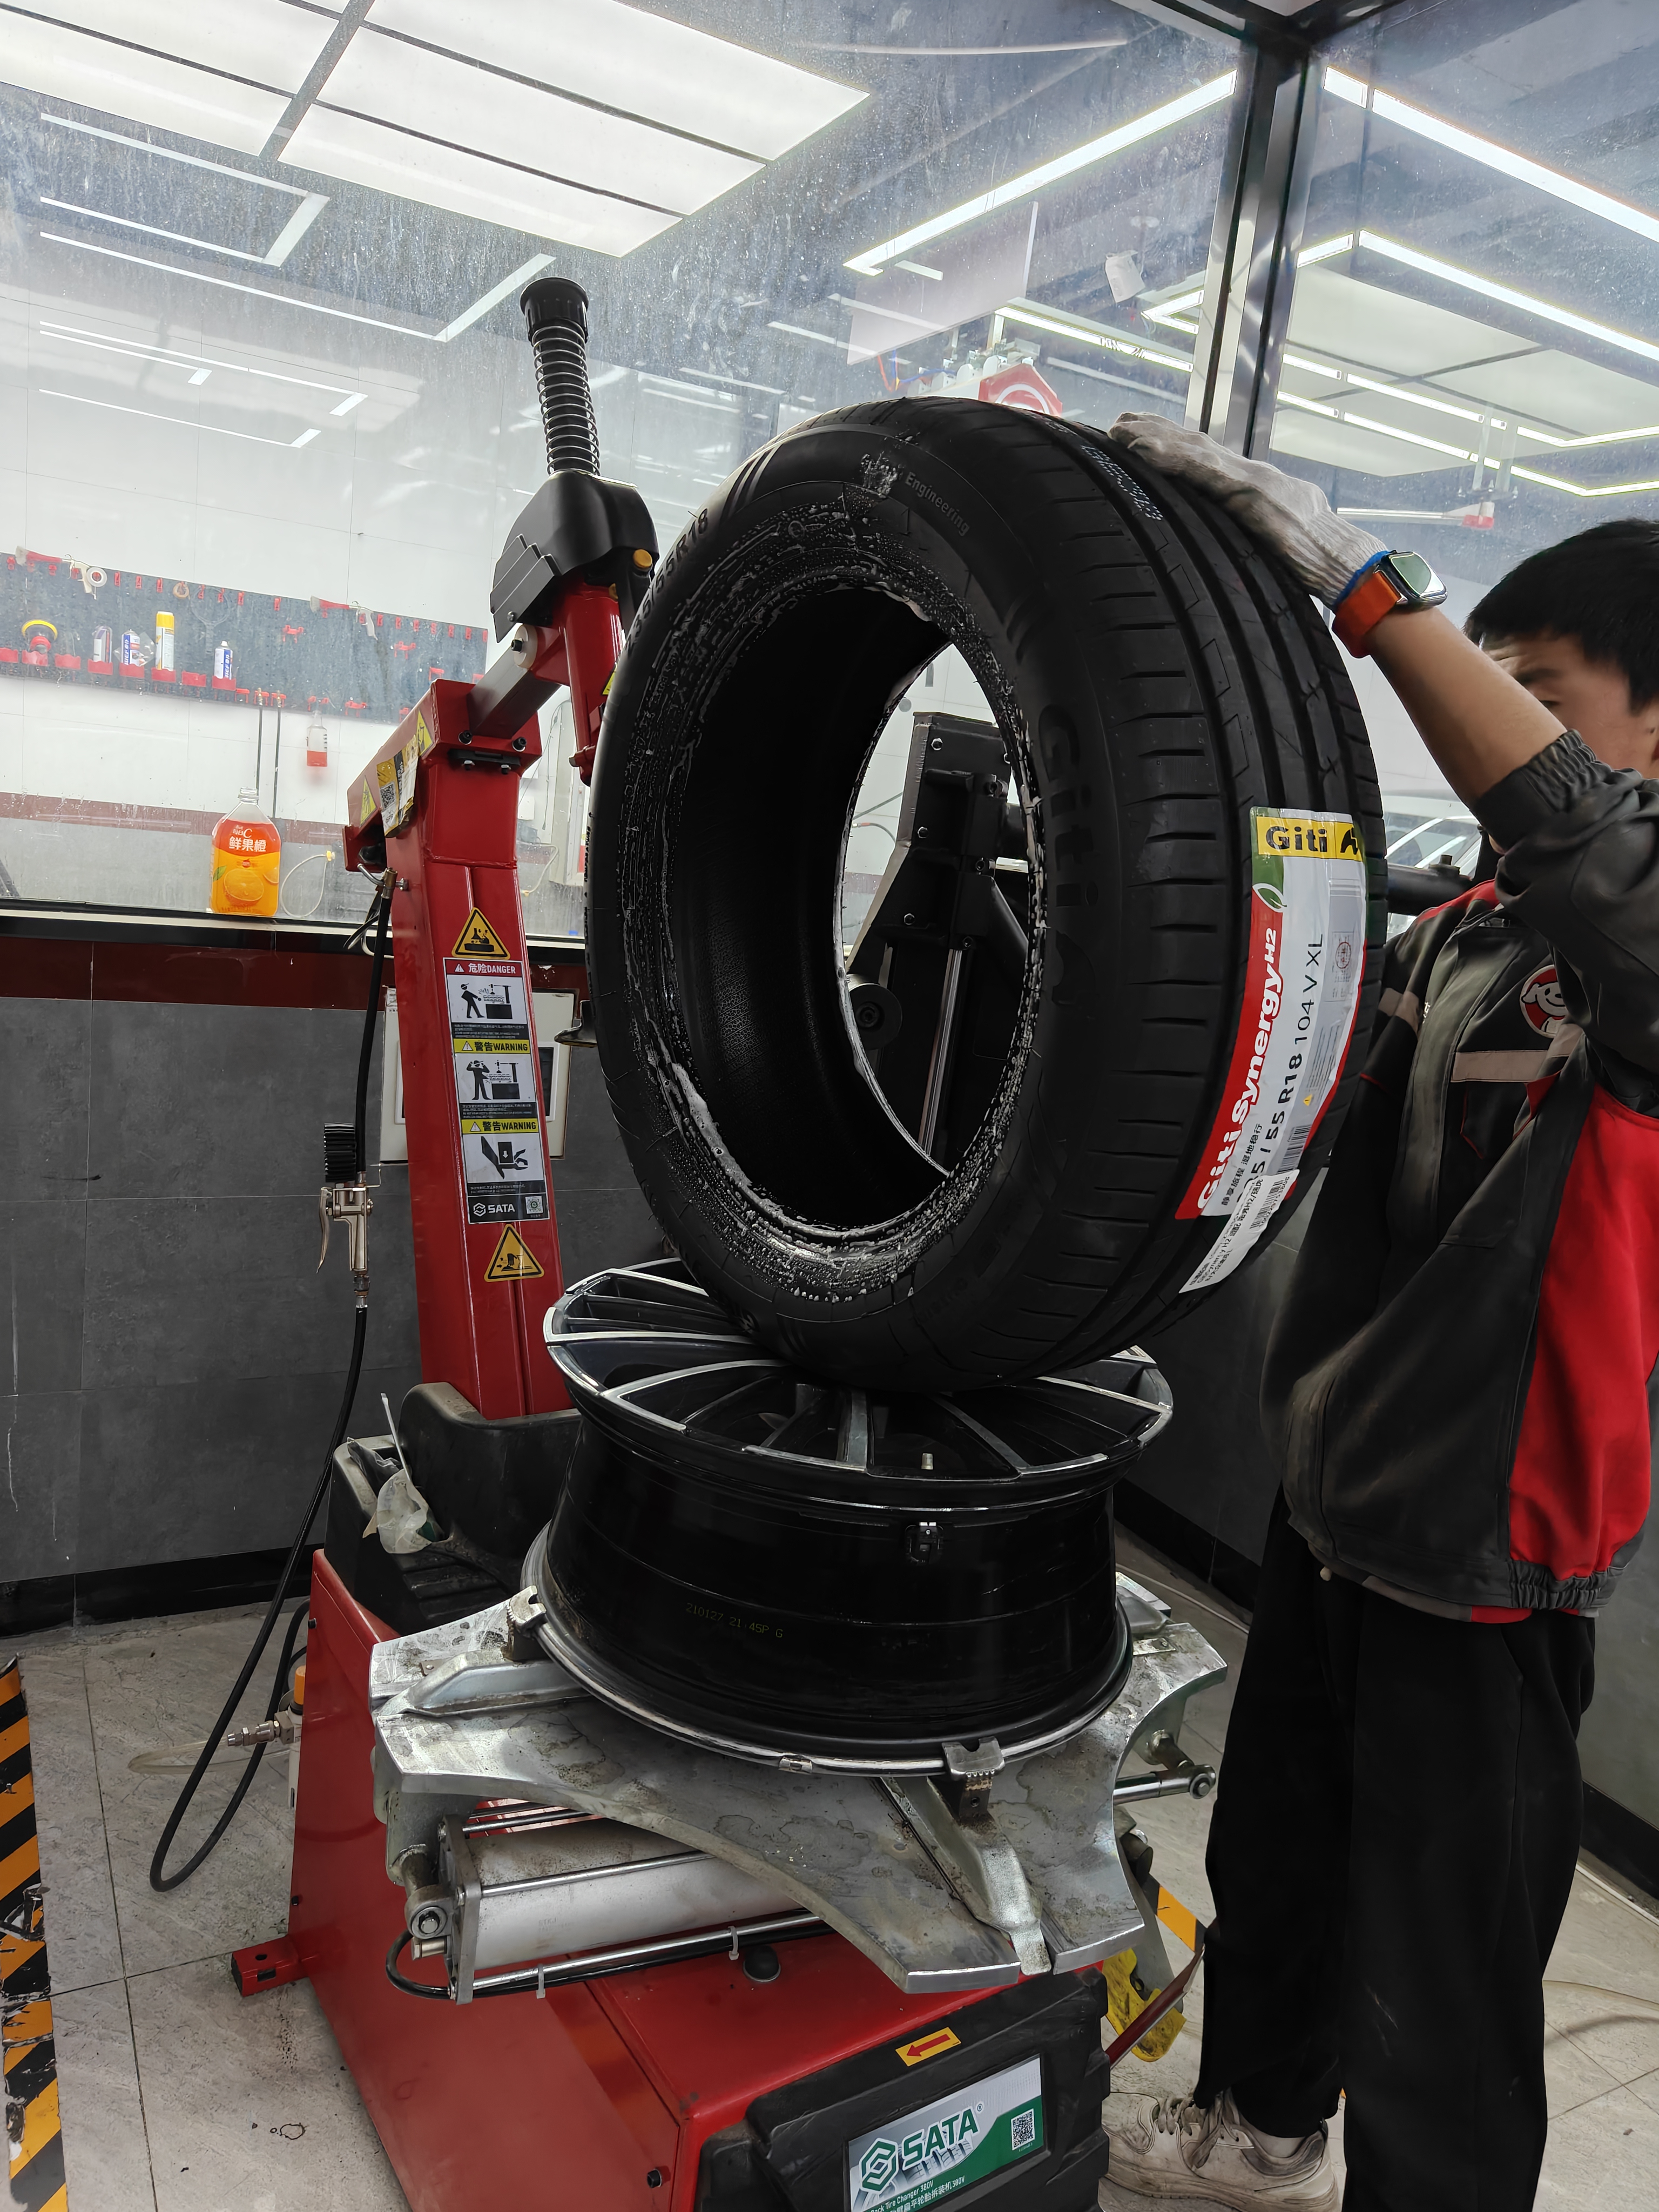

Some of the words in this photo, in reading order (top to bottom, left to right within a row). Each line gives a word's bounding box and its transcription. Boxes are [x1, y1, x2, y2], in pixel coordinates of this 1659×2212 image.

[905, 471, 970, 536] Engineering
[229, 836, 266, 852] 鲜果橙
[1265, 826, 1327, 853] Giti
[1306, 933, 1323, 967] XL
[488, 1203, 516, 1213] SATA
[685, 1602, 724, 1621] 210127
[902, 2108, 979, 2169] SATA
[886, 2201, 896, 2210] Tire
[897, 2188, 920, 2204] Changer
[920, 2180, 934, 2193] 380V
